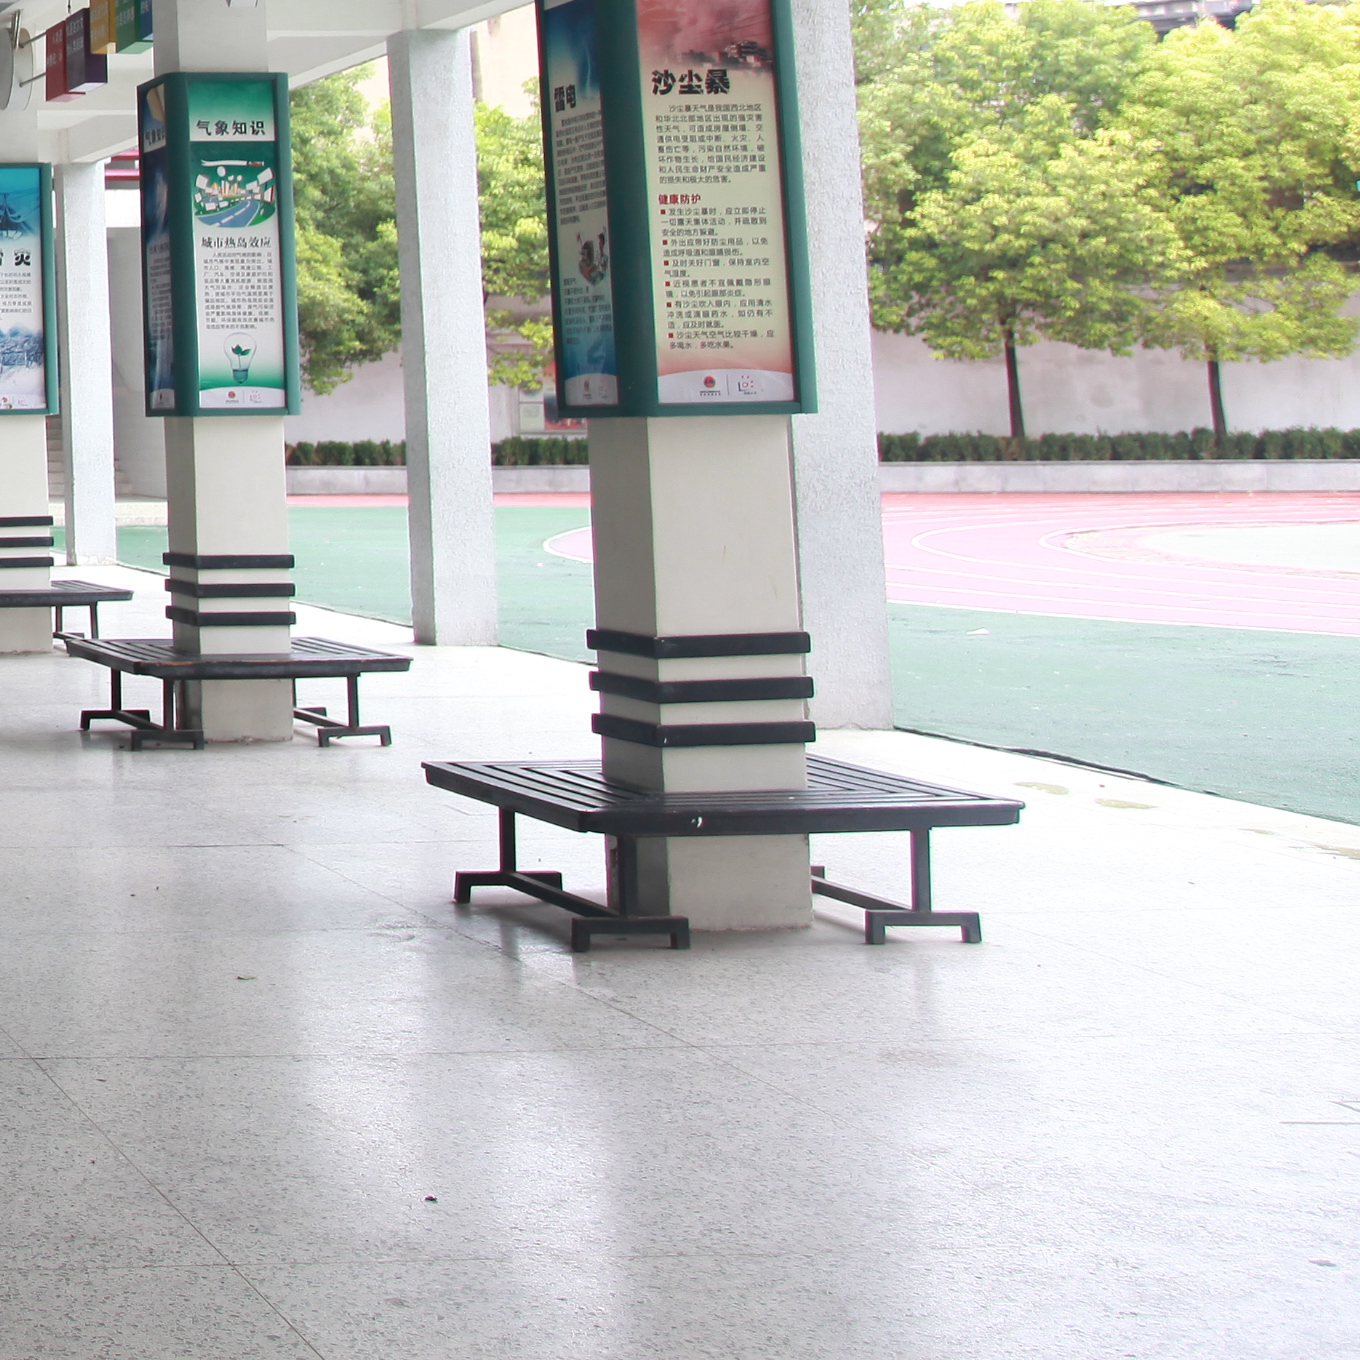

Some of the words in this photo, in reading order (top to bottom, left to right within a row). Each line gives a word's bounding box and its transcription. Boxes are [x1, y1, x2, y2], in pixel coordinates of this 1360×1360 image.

[651, 69, 730, 95] 沙尘暴
[553, 84, 577, 113] 雷电
[196, 119, 266, 137] 气象知识
[658, 194, 701, 204] 健康防护
